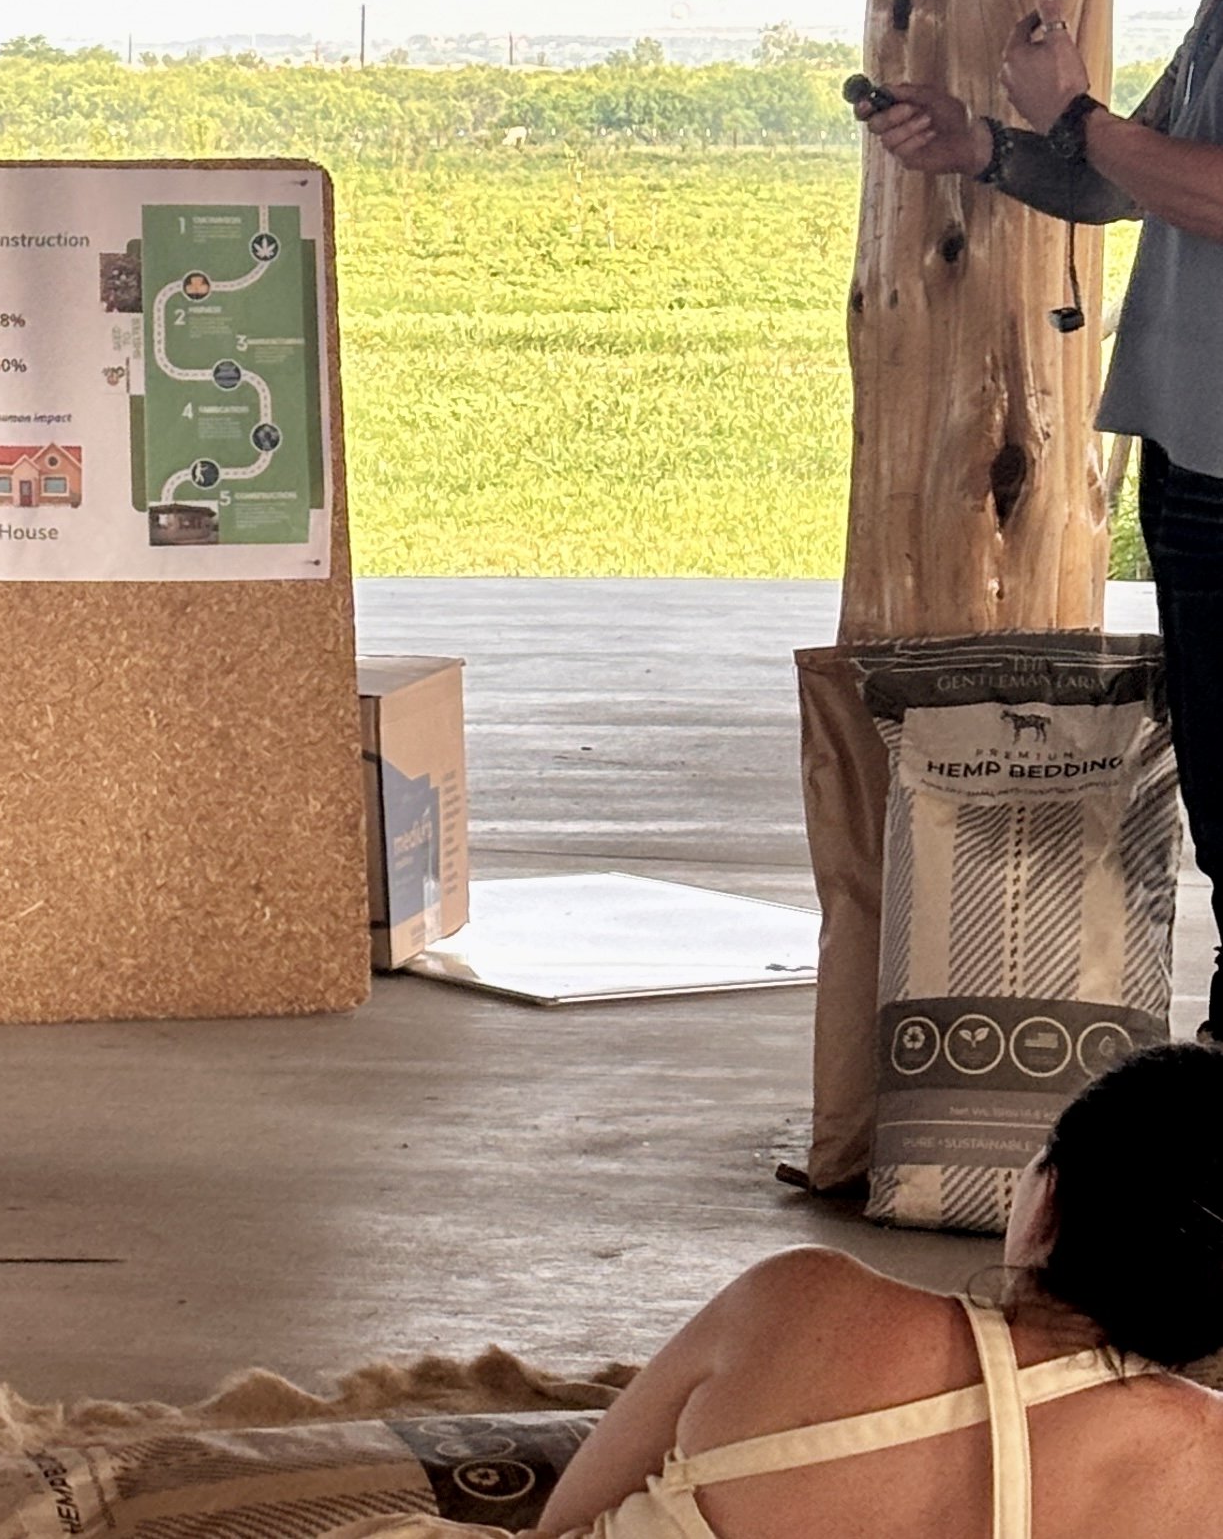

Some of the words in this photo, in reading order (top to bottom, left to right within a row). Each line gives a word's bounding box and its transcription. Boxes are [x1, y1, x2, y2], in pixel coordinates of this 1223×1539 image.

[174, 309, 186, 326] 2
[236, 335, 248, 351] 3
[33, 412, 72, 425] impact
[182, 402, 193, 419] 4
[219, 490, 231, 507] 5
[975, 747, 1074, 760] PREMIUM
[927, 759, 1001, 779] HEMP
[1009, 756, 1124, 779] BEDDING
[903, 1137, 935, 1149] PURE
[944, 1137, 1033, 1152] SUSTAINABLE
